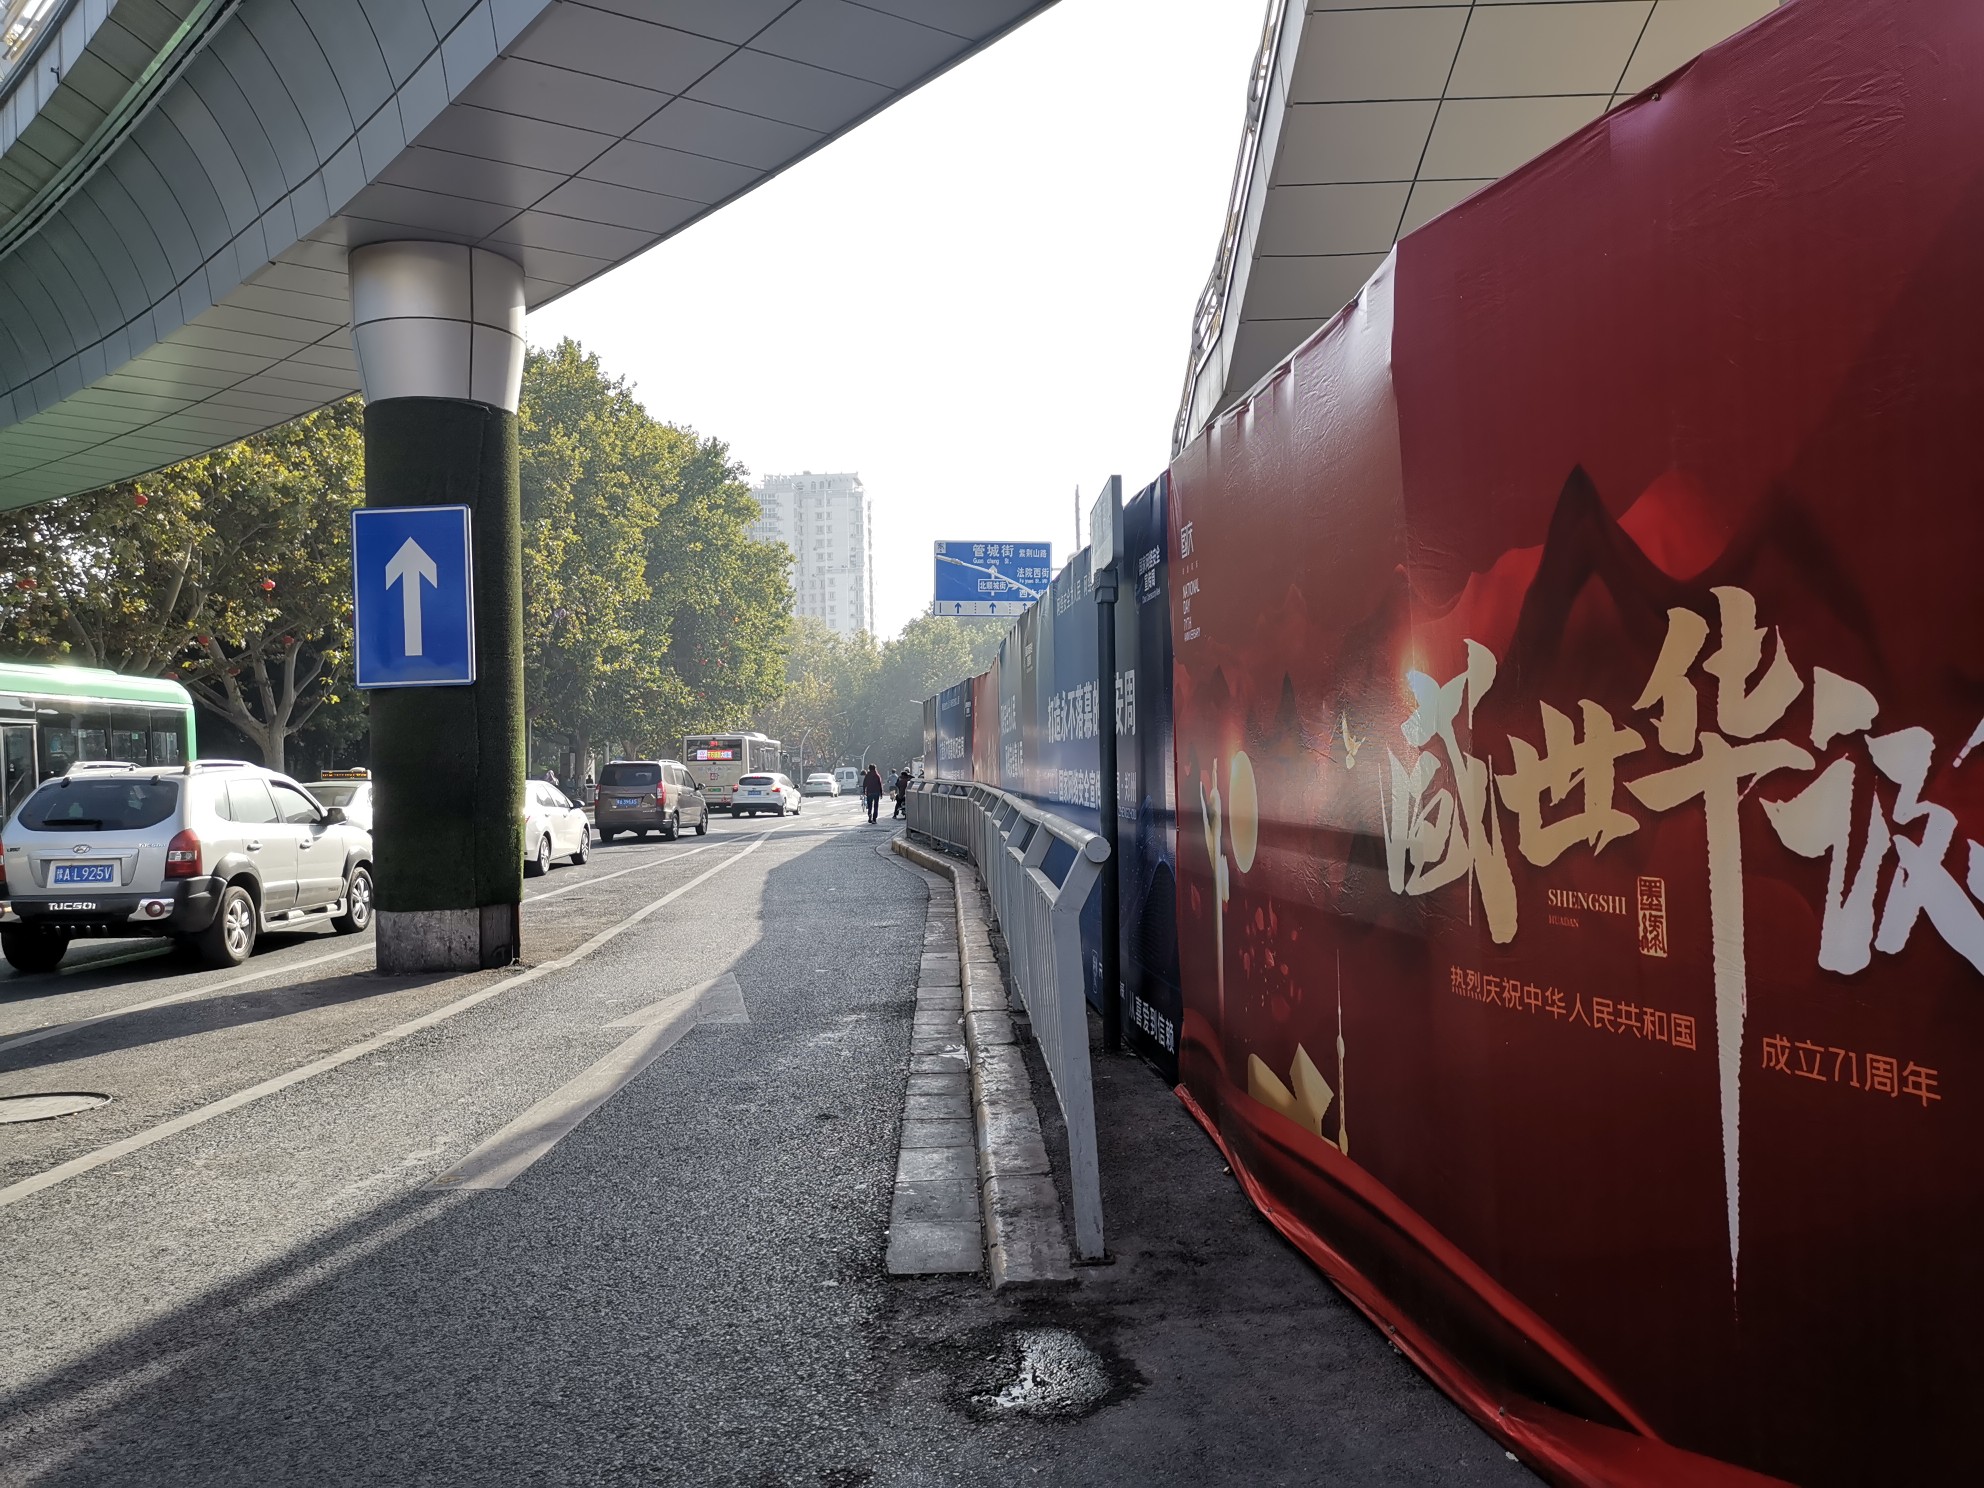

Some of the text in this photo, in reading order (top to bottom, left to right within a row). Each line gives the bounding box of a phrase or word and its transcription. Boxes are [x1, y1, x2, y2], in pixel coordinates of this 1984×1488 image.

[973, 544, 1014, 557] 管城街
[1017, 567, 1049, 578] 法院西街
[1548, 889, 1627, 915] SHENGSHI
[1450, 965, 1942, 1108] 热烈庆祝中华人民共和国 成立71周年
